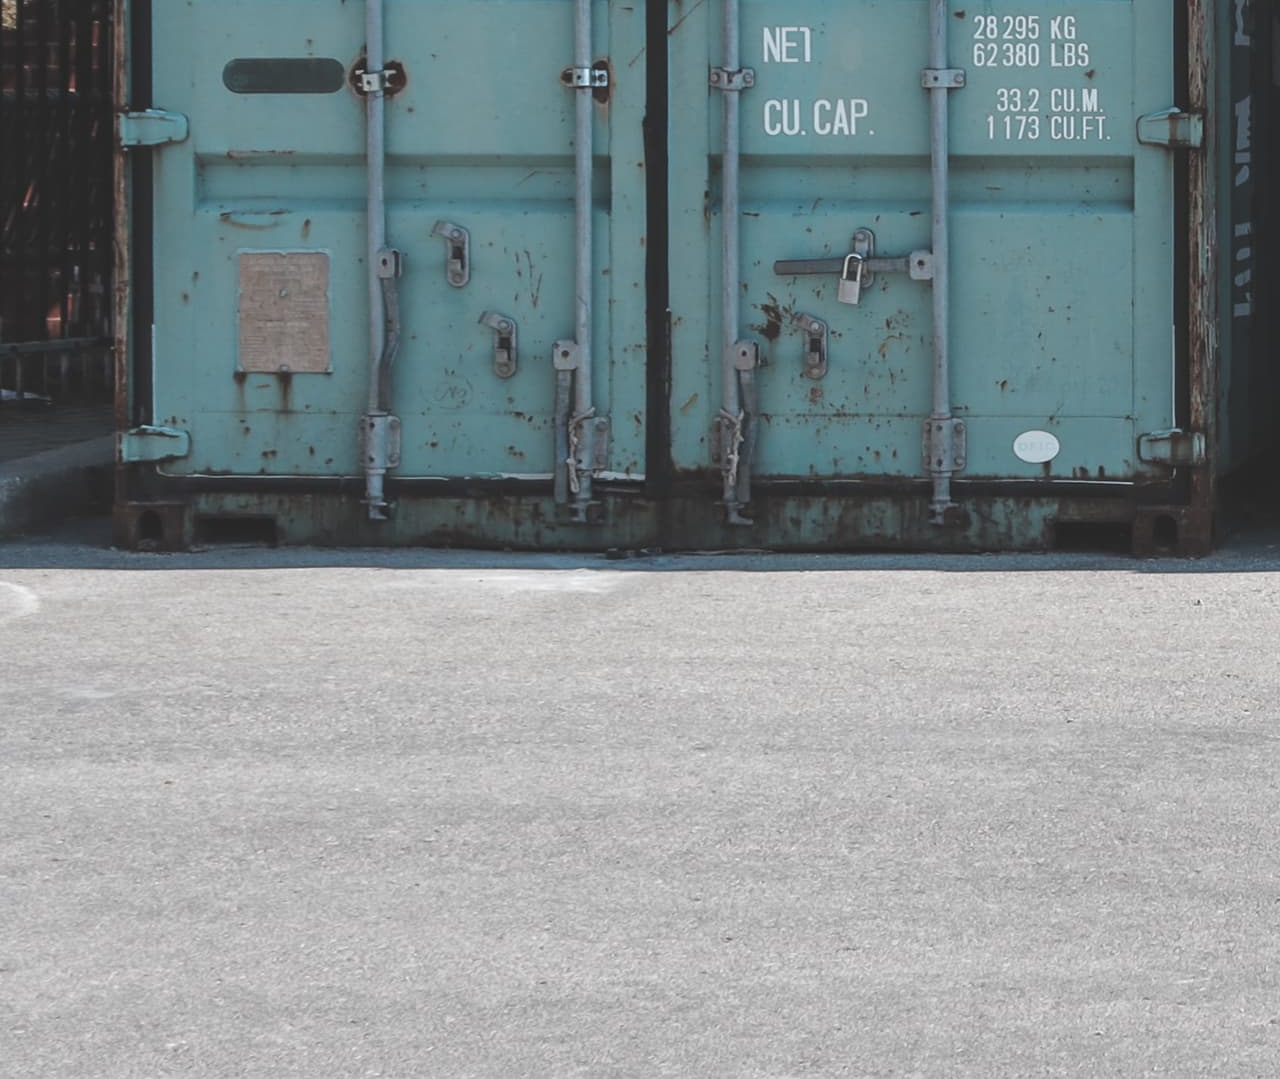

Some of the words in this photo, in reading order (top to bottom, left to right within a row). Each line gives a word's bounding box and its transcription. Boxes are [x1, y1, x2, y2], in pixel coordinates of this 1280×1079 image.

[762, 26, 812, 63] NET
[1050, 15, 1076, 40] KG
[1050, 42, 1090, 67] LBS
[763, 98, 807, 136] CU.
[996, 88, 1040, 112] 33.2
[1050, 88, 1104, 113] CU.M.
[1050, 115, 1112, 140] CU.FT.
